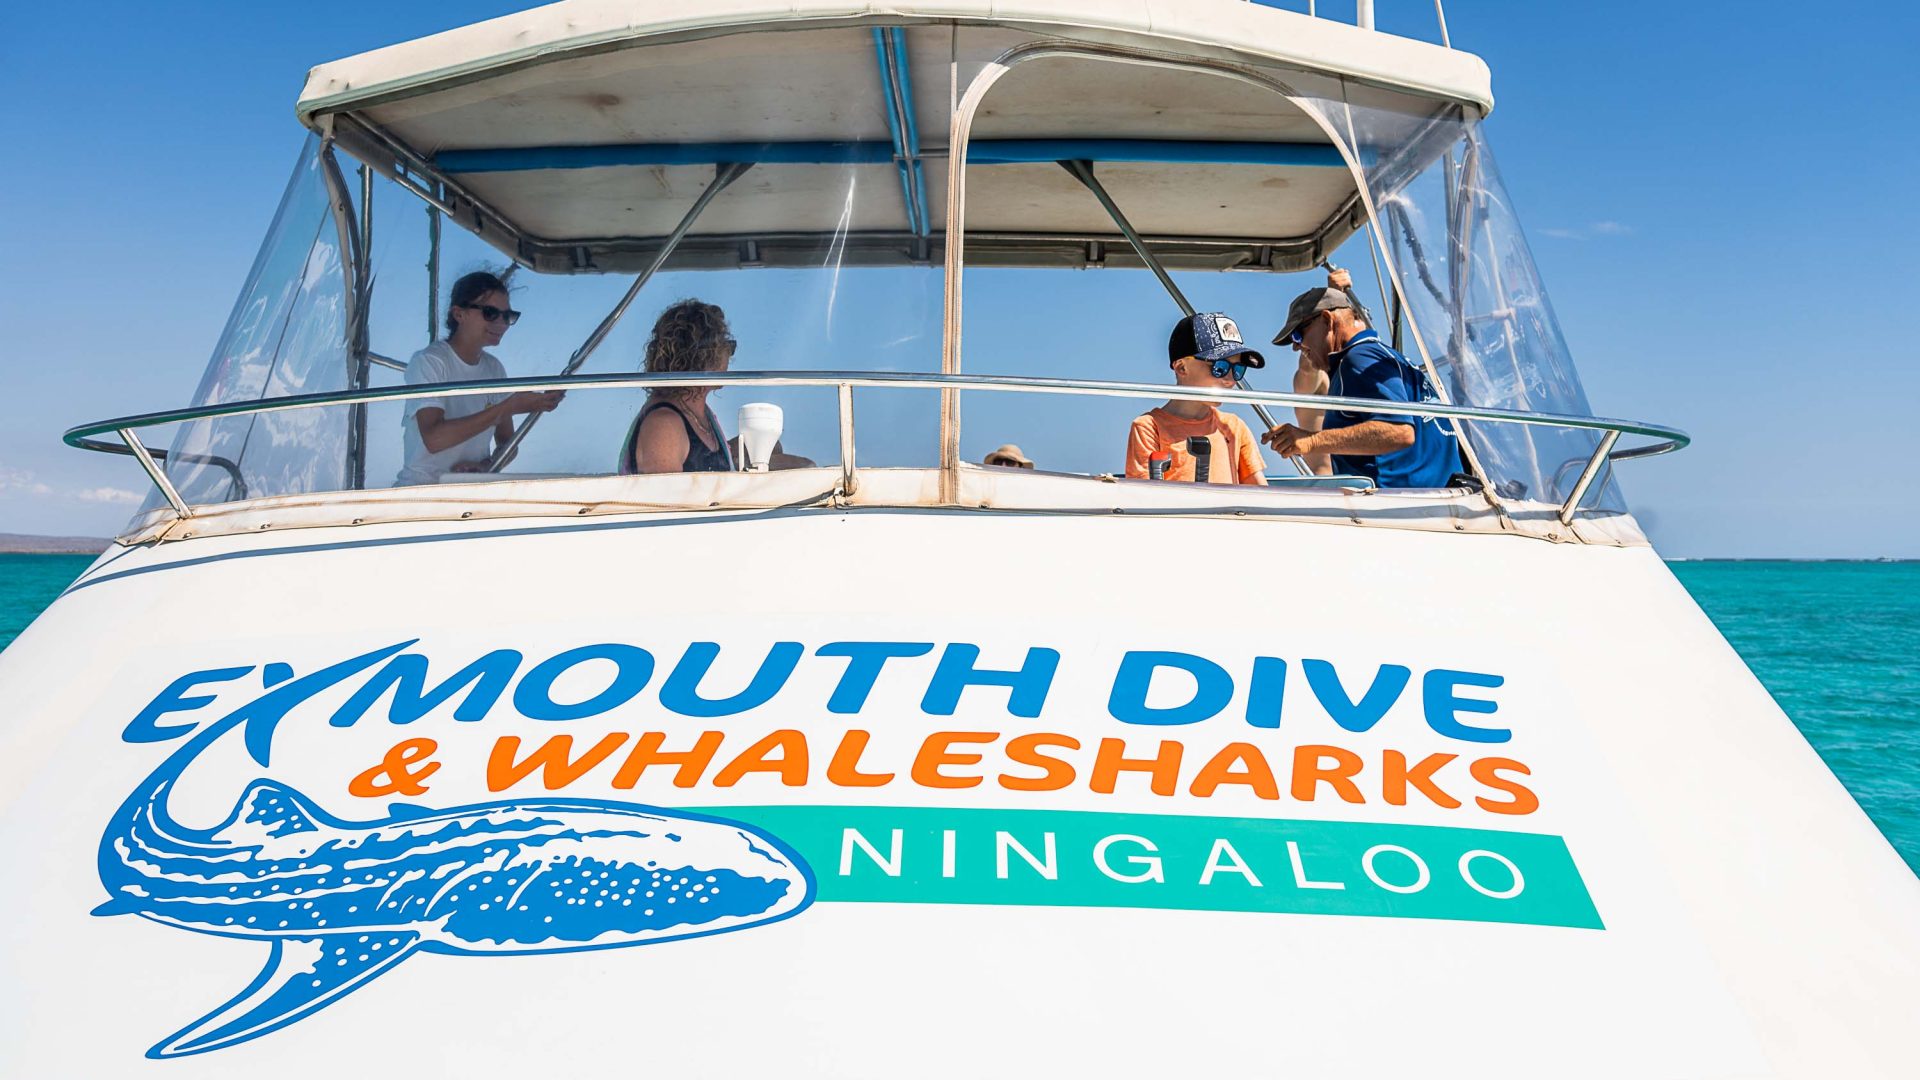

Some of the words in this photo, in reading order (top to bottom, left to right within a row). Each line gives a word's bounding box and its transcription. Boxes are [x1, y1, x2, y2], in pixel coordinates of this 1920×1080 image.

[122, 639, 1060, 767] EXMOUTH
[1108, 651, 1512, 743] DIVE
[348, 738, 441, 798] &
[487, 729, 1539, 815] WHALESHARKS
[840, 828, 1524, 900] NINGALOO
